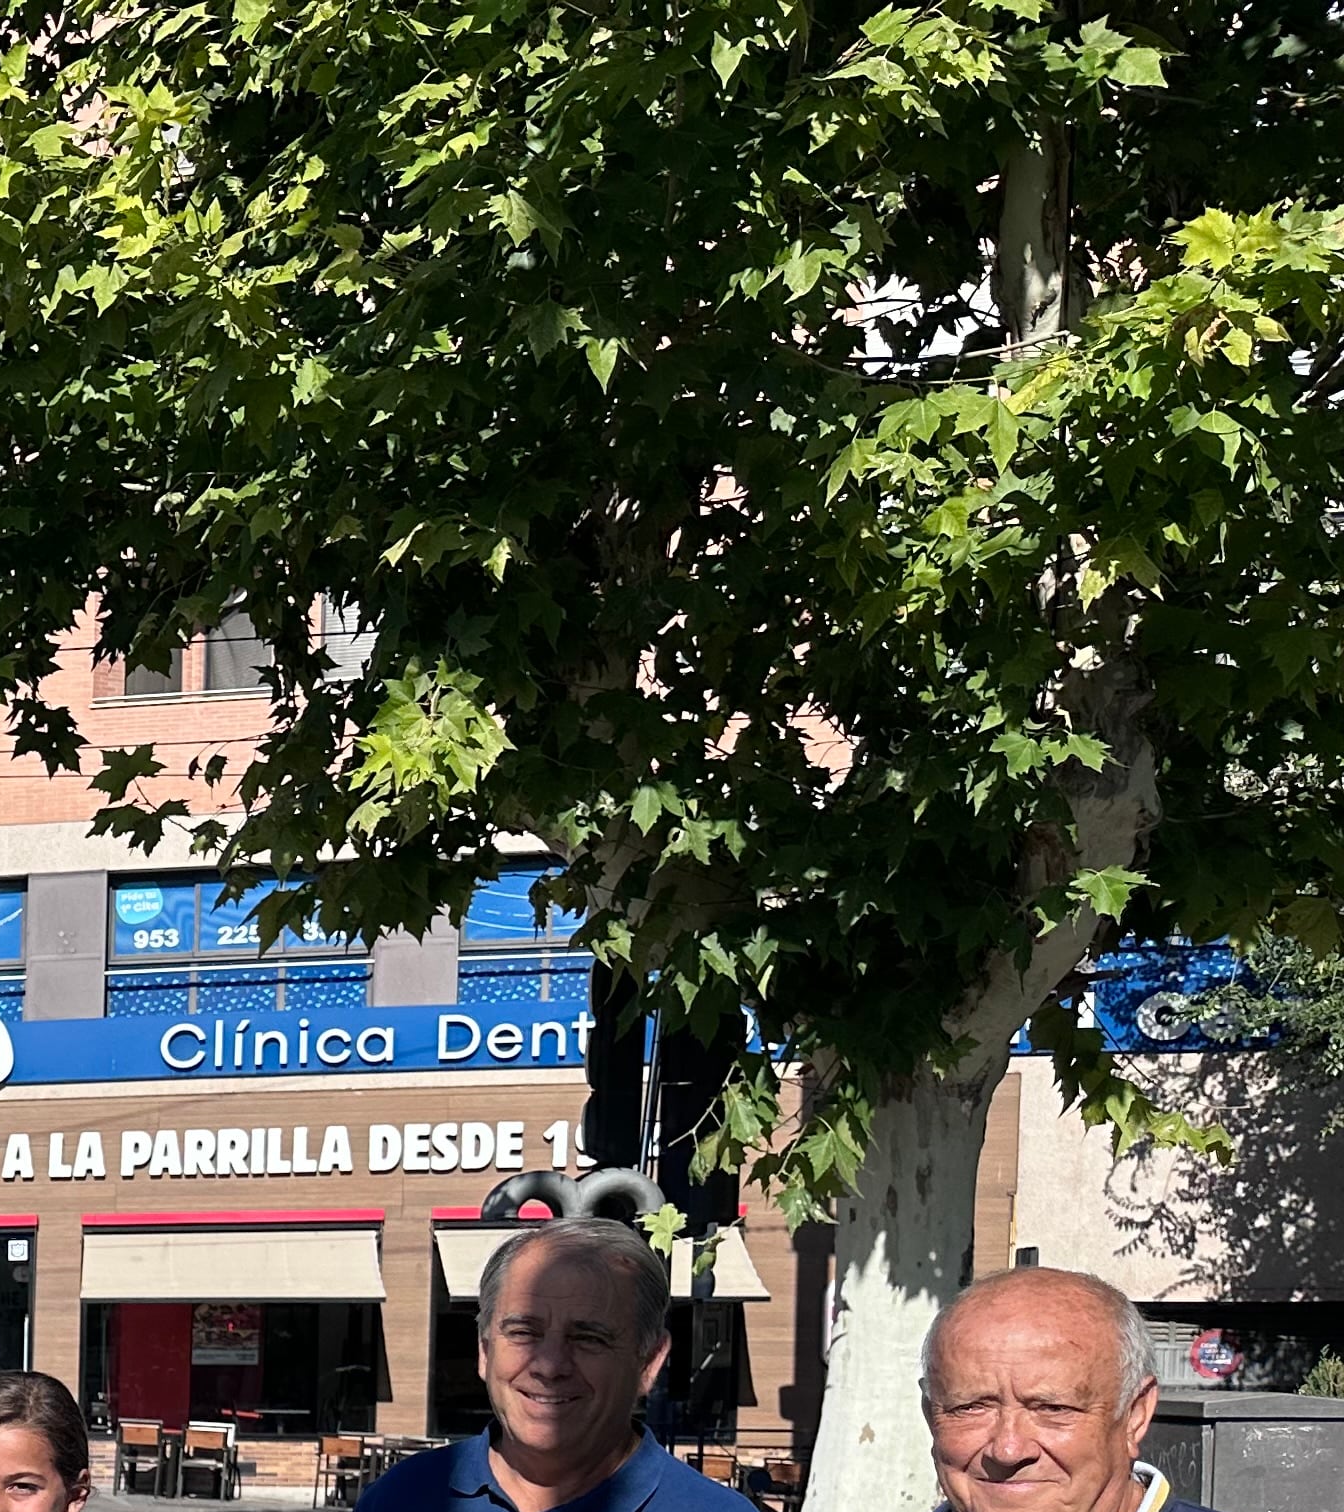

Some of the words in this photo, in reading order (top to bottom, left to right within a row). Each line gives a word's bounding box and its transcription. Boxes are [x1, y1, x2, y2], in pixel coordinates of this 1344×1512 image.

[134, 928, 180, 949] 953
[160, 1018, 394, 1070] Clínica
[1, 1133, 34, 1180] A
[48, 1130, 106, 1180] LA
[122, 1124, 353, 1178] PARRILLA
[369, 1121, 524, 1173] DESDE
